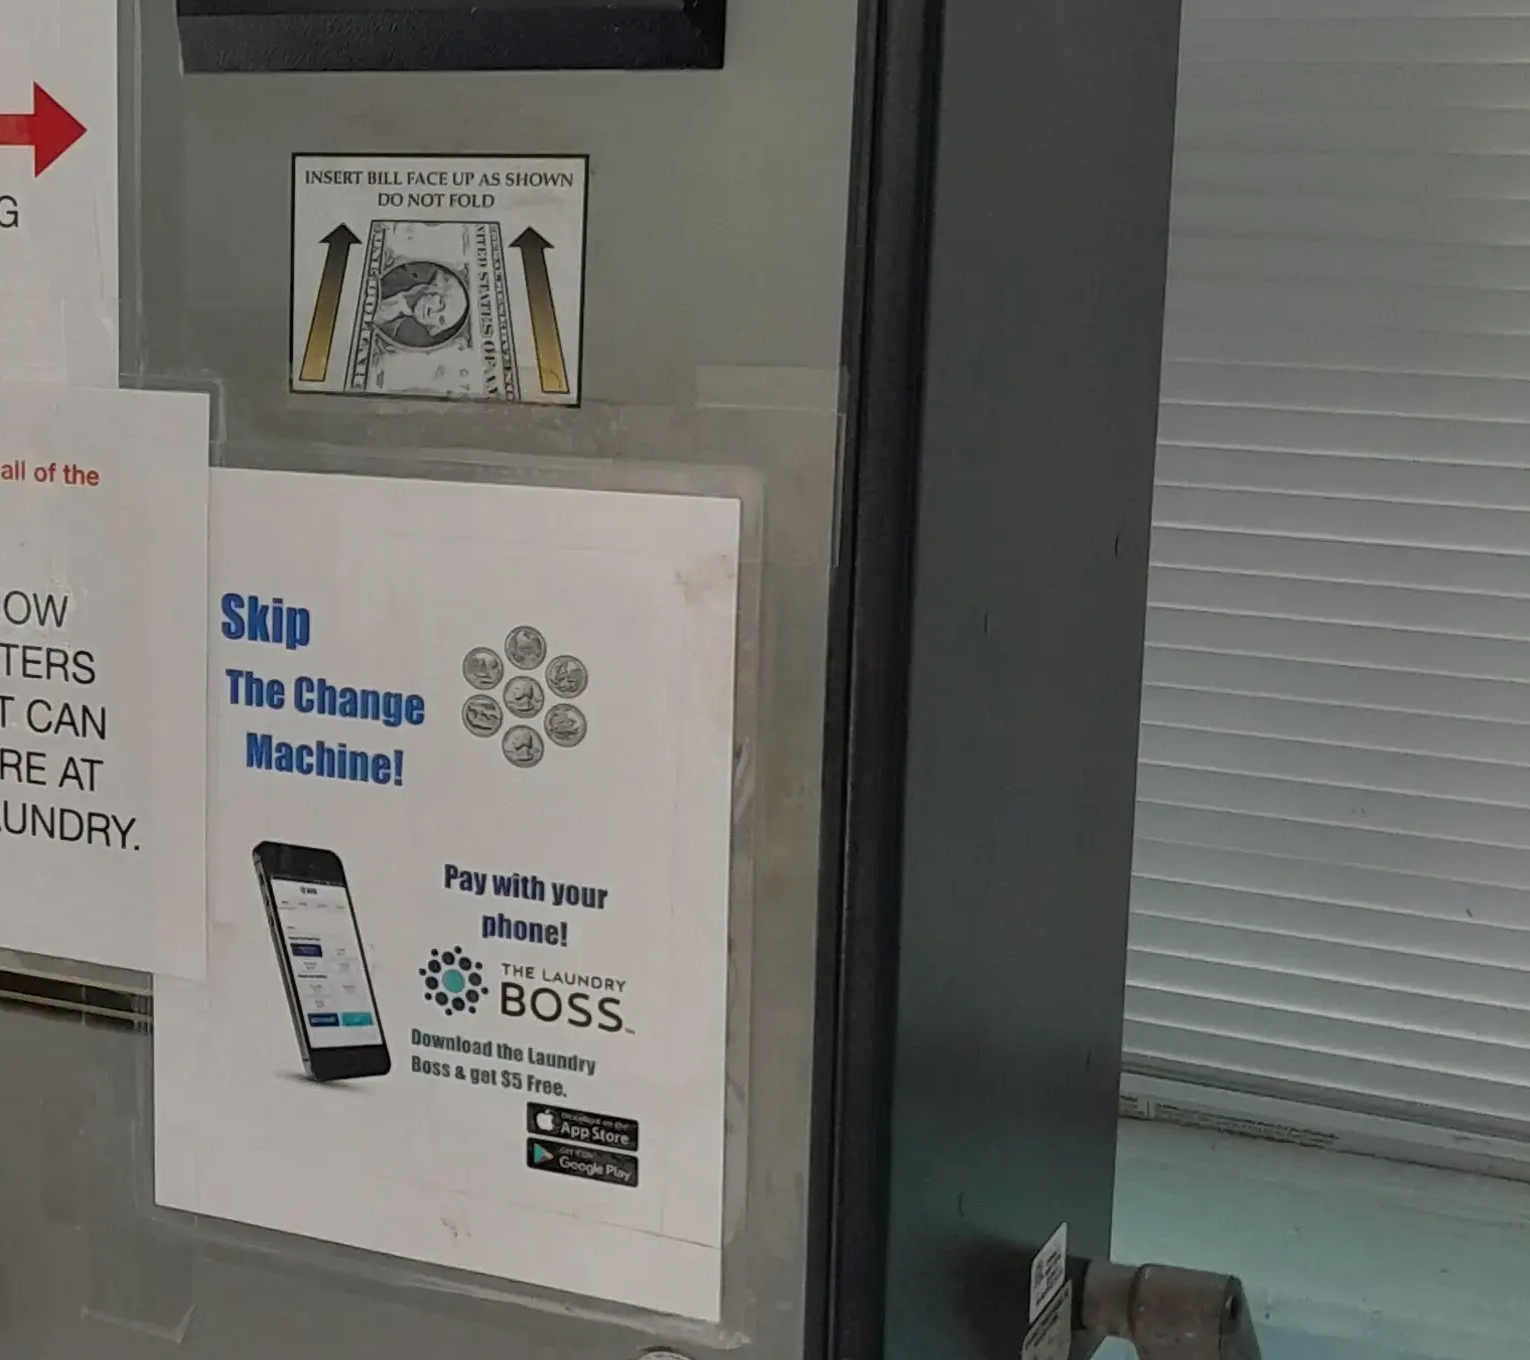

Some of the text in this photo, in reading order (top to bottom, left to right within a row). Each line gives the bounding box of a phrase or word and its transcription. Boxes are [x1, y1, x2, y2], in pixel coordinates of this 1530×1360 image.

[305, 171, 574, 187] INSERT BILL FACE UP AS SHOWN
[378, 193, 495, 208] DO NOT FOLD
[478, 271, 494, 338] STATES
[1, 460, 25, 480] all
[34, 463, 56, 482] of
[63, 464, 99, 486] the
[221, 593, 310, 650] Skip
[226, 669, 425, 727] The Change
[27, 699, 105, 740] CAN
[59, 757, 103, 791] AT
[246, 732, 403, 786] Machine!
[444, 864, 608, 909] Pay with your
[482, 913, 567, 947] phone!
[501, 963, 626, 992] THE LAUNDRY
[501, 982, 623, 1032] BOSS
[411, 1028, 595, 1076] Download the Laundry
[412, 1056, 567, 1097] Boss & get $5 Free.
[561, 1122, 630, 1145] App Store
[559, 1156, 631, 1181] Google Play
